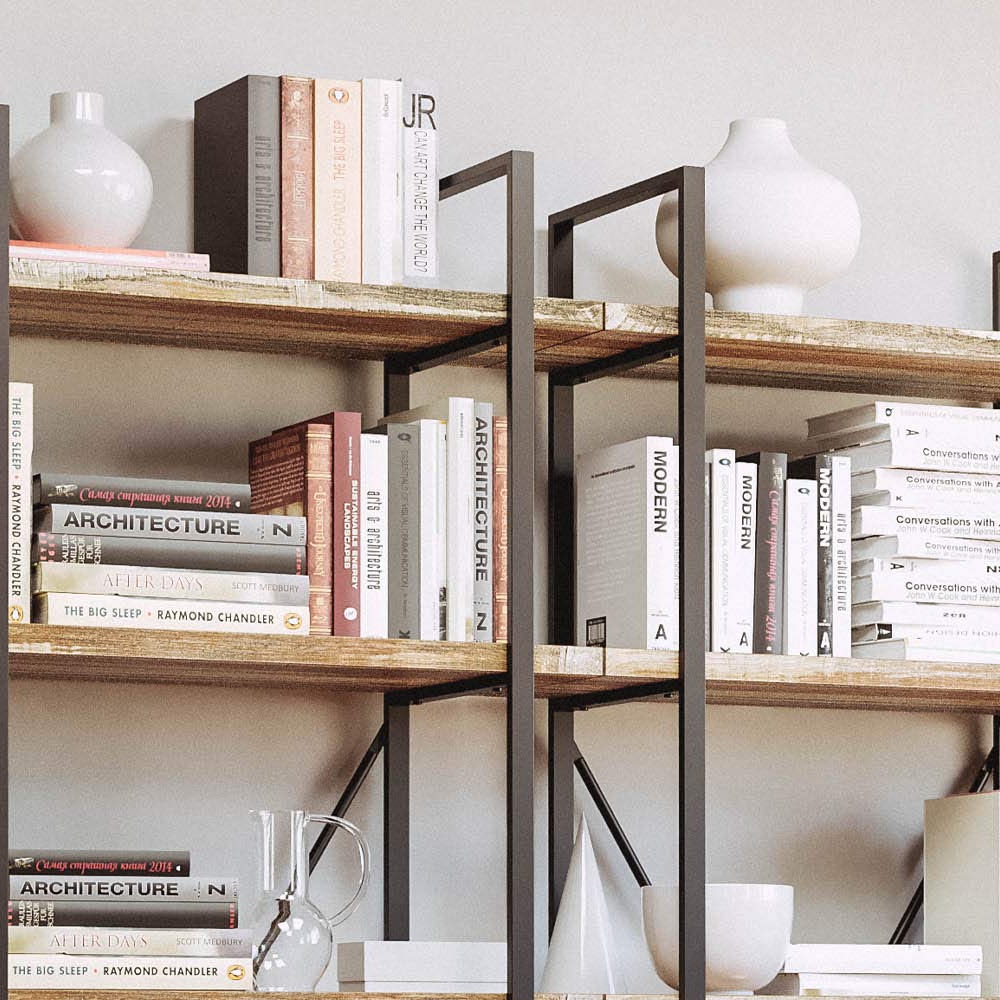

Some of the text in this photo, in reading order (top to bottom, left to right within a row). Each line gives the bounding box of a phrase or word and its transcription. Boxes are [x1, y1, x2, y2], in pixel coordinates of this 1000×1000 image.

[403, 93, 436, 130] JR
[414, 131, 427, 272] CAN ART CHANGE THE WORLD?
[923, 448, 988, 460] Conversations
[906, 476, 971, 486] Conversations
[12, 398, 21, 597] THE BIG SLEEP RAYMOND CHANDLER
[80, 488, 233, 509] Самая страшная книга 2014
[476, 418, 487, 581] ARCHITECTURE
[654, 451, 667, 532] MODERN
[741, 475, 752, 549] MODERN
[820, 468, 830, 547] MODERN
[64, 512, 240, 535] ARCHITECTURE
[896, 516, 994, 526] Conversations with
[231, 582, 299, 593] SCOTT MEDBURY
[906, 582, 1000, 593] Conversations with
[65, 606, 274, 624] THE BIG SLEEP RAYMOND CHANDLER
[36, 858, 67, 870] Самая
[70, 861, 117, 873] страшная
[149, 862, 173, 872] 2014
[20, 882, 178, 896] ARCHITECTURE
[13, 966, 217, 976] THE BIG SLEEP RAYMOND CHANDLER
